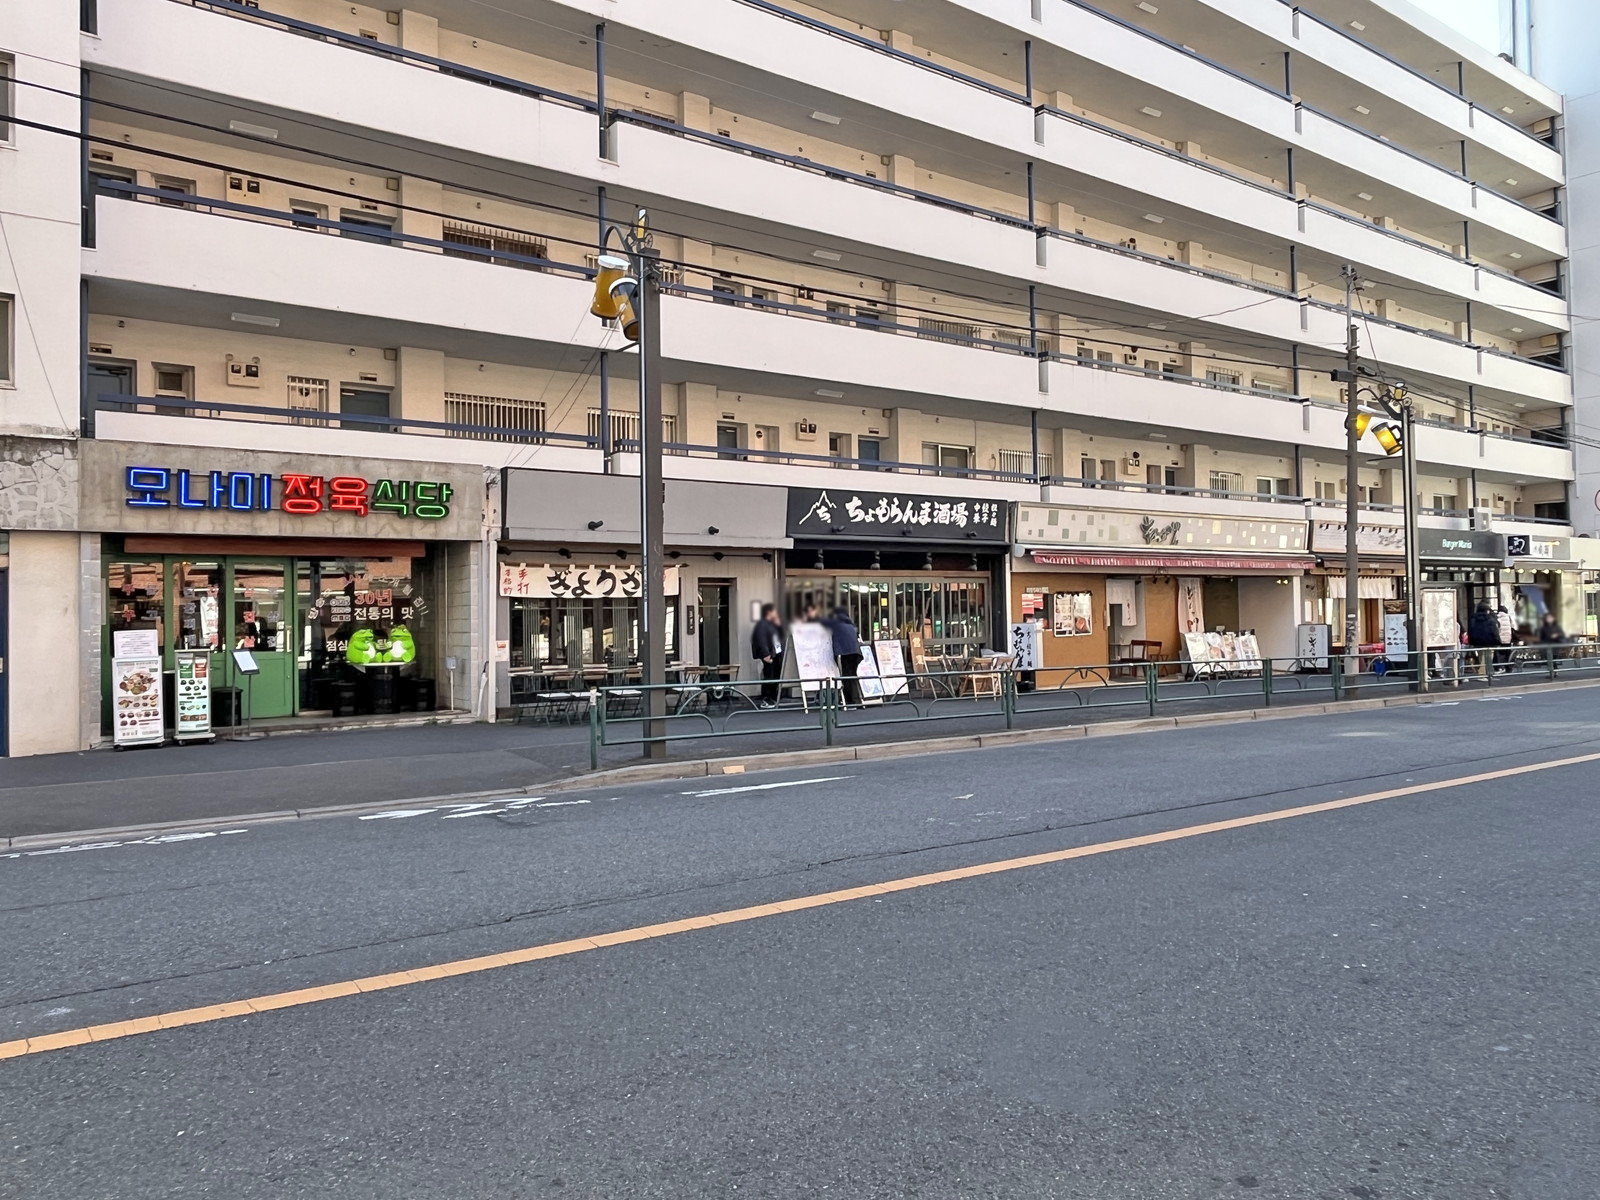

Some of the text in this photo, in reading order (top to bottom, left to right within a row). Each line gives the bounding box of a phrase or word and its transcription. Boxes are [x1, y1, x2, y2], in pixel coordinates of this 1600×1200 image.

[126, 466, 272, 512] 모나미
[845, 495, 969, 528] ちょもらんま酒場
[1442, 538, 1459, 550] Burger
[354, 588, 393, 606] 30년
[353, 606, 394, 620] 전통의
[401, 606, 414, 620] 맛
[326, 639, 348, 652] 점심
